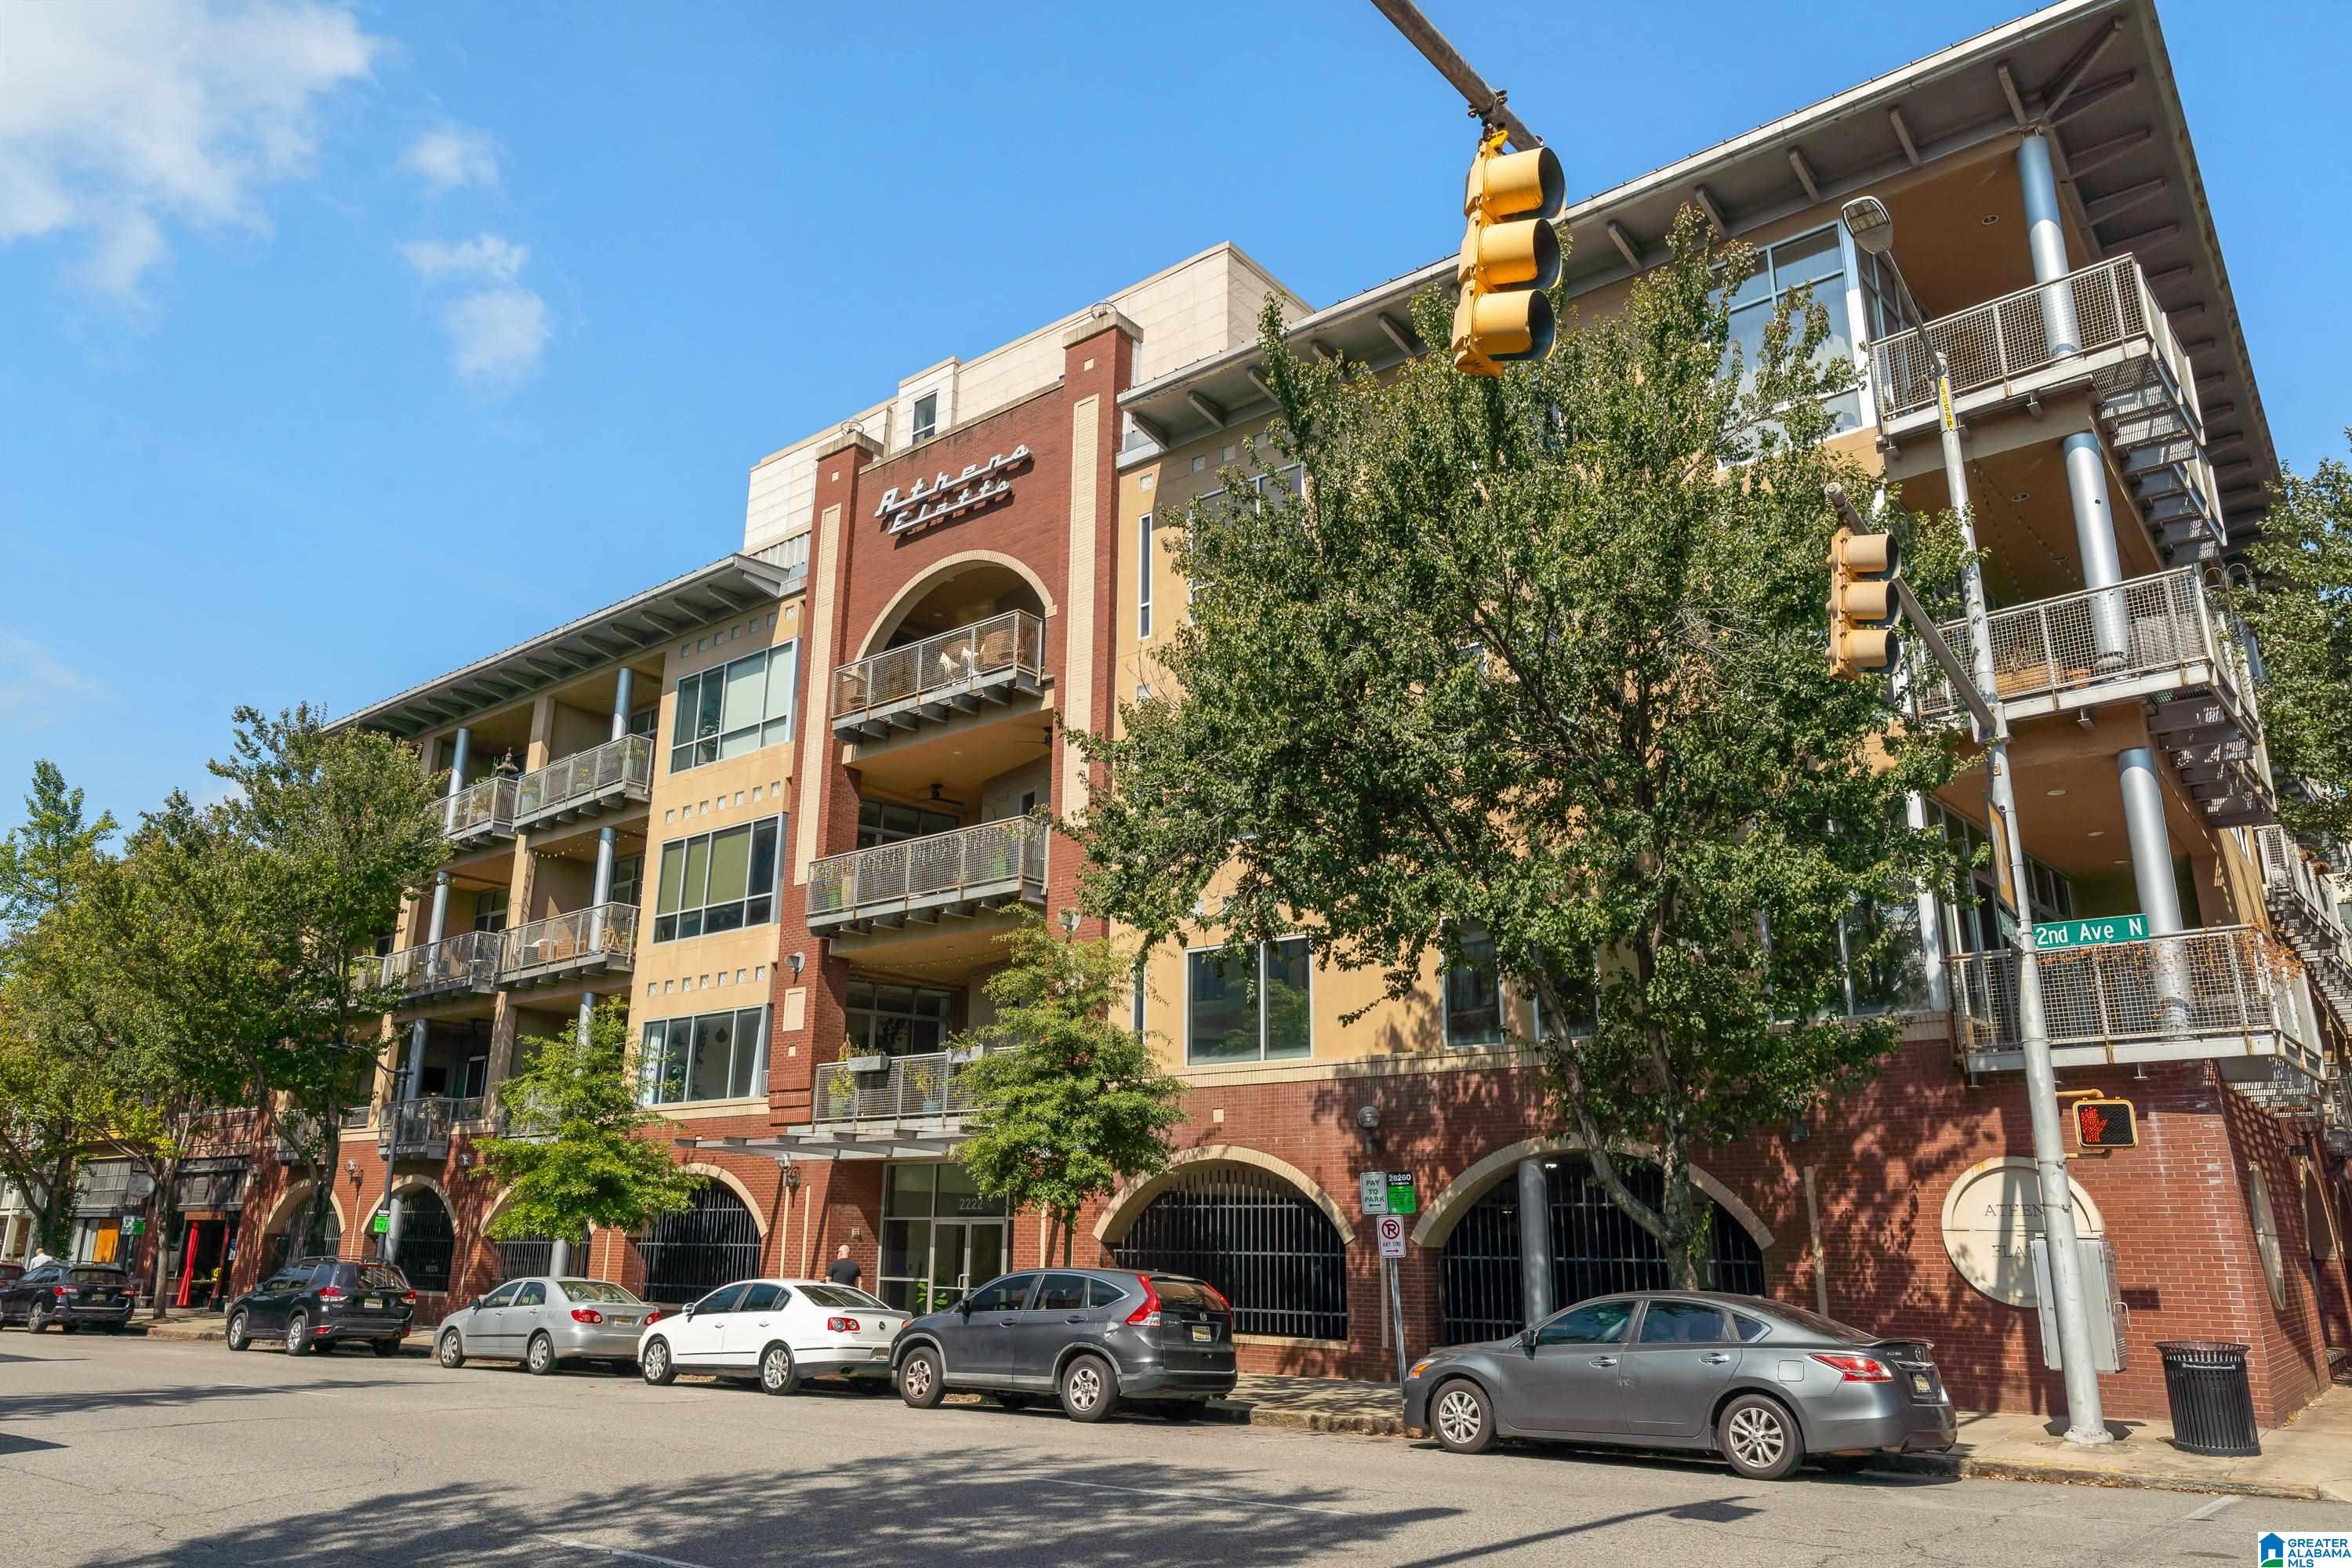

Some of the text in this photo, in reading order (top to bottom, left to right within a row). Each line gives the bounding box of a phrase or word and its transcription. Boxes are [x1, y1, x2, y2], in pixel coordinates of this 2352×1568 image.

[874, 444, 1031, 518] Athens
[2036, 917, 2143, 946] 2nd Ave N
[959, 1197, 984, 1210] 2222
[1984, 1203, 2044, 1217] ATHEN
